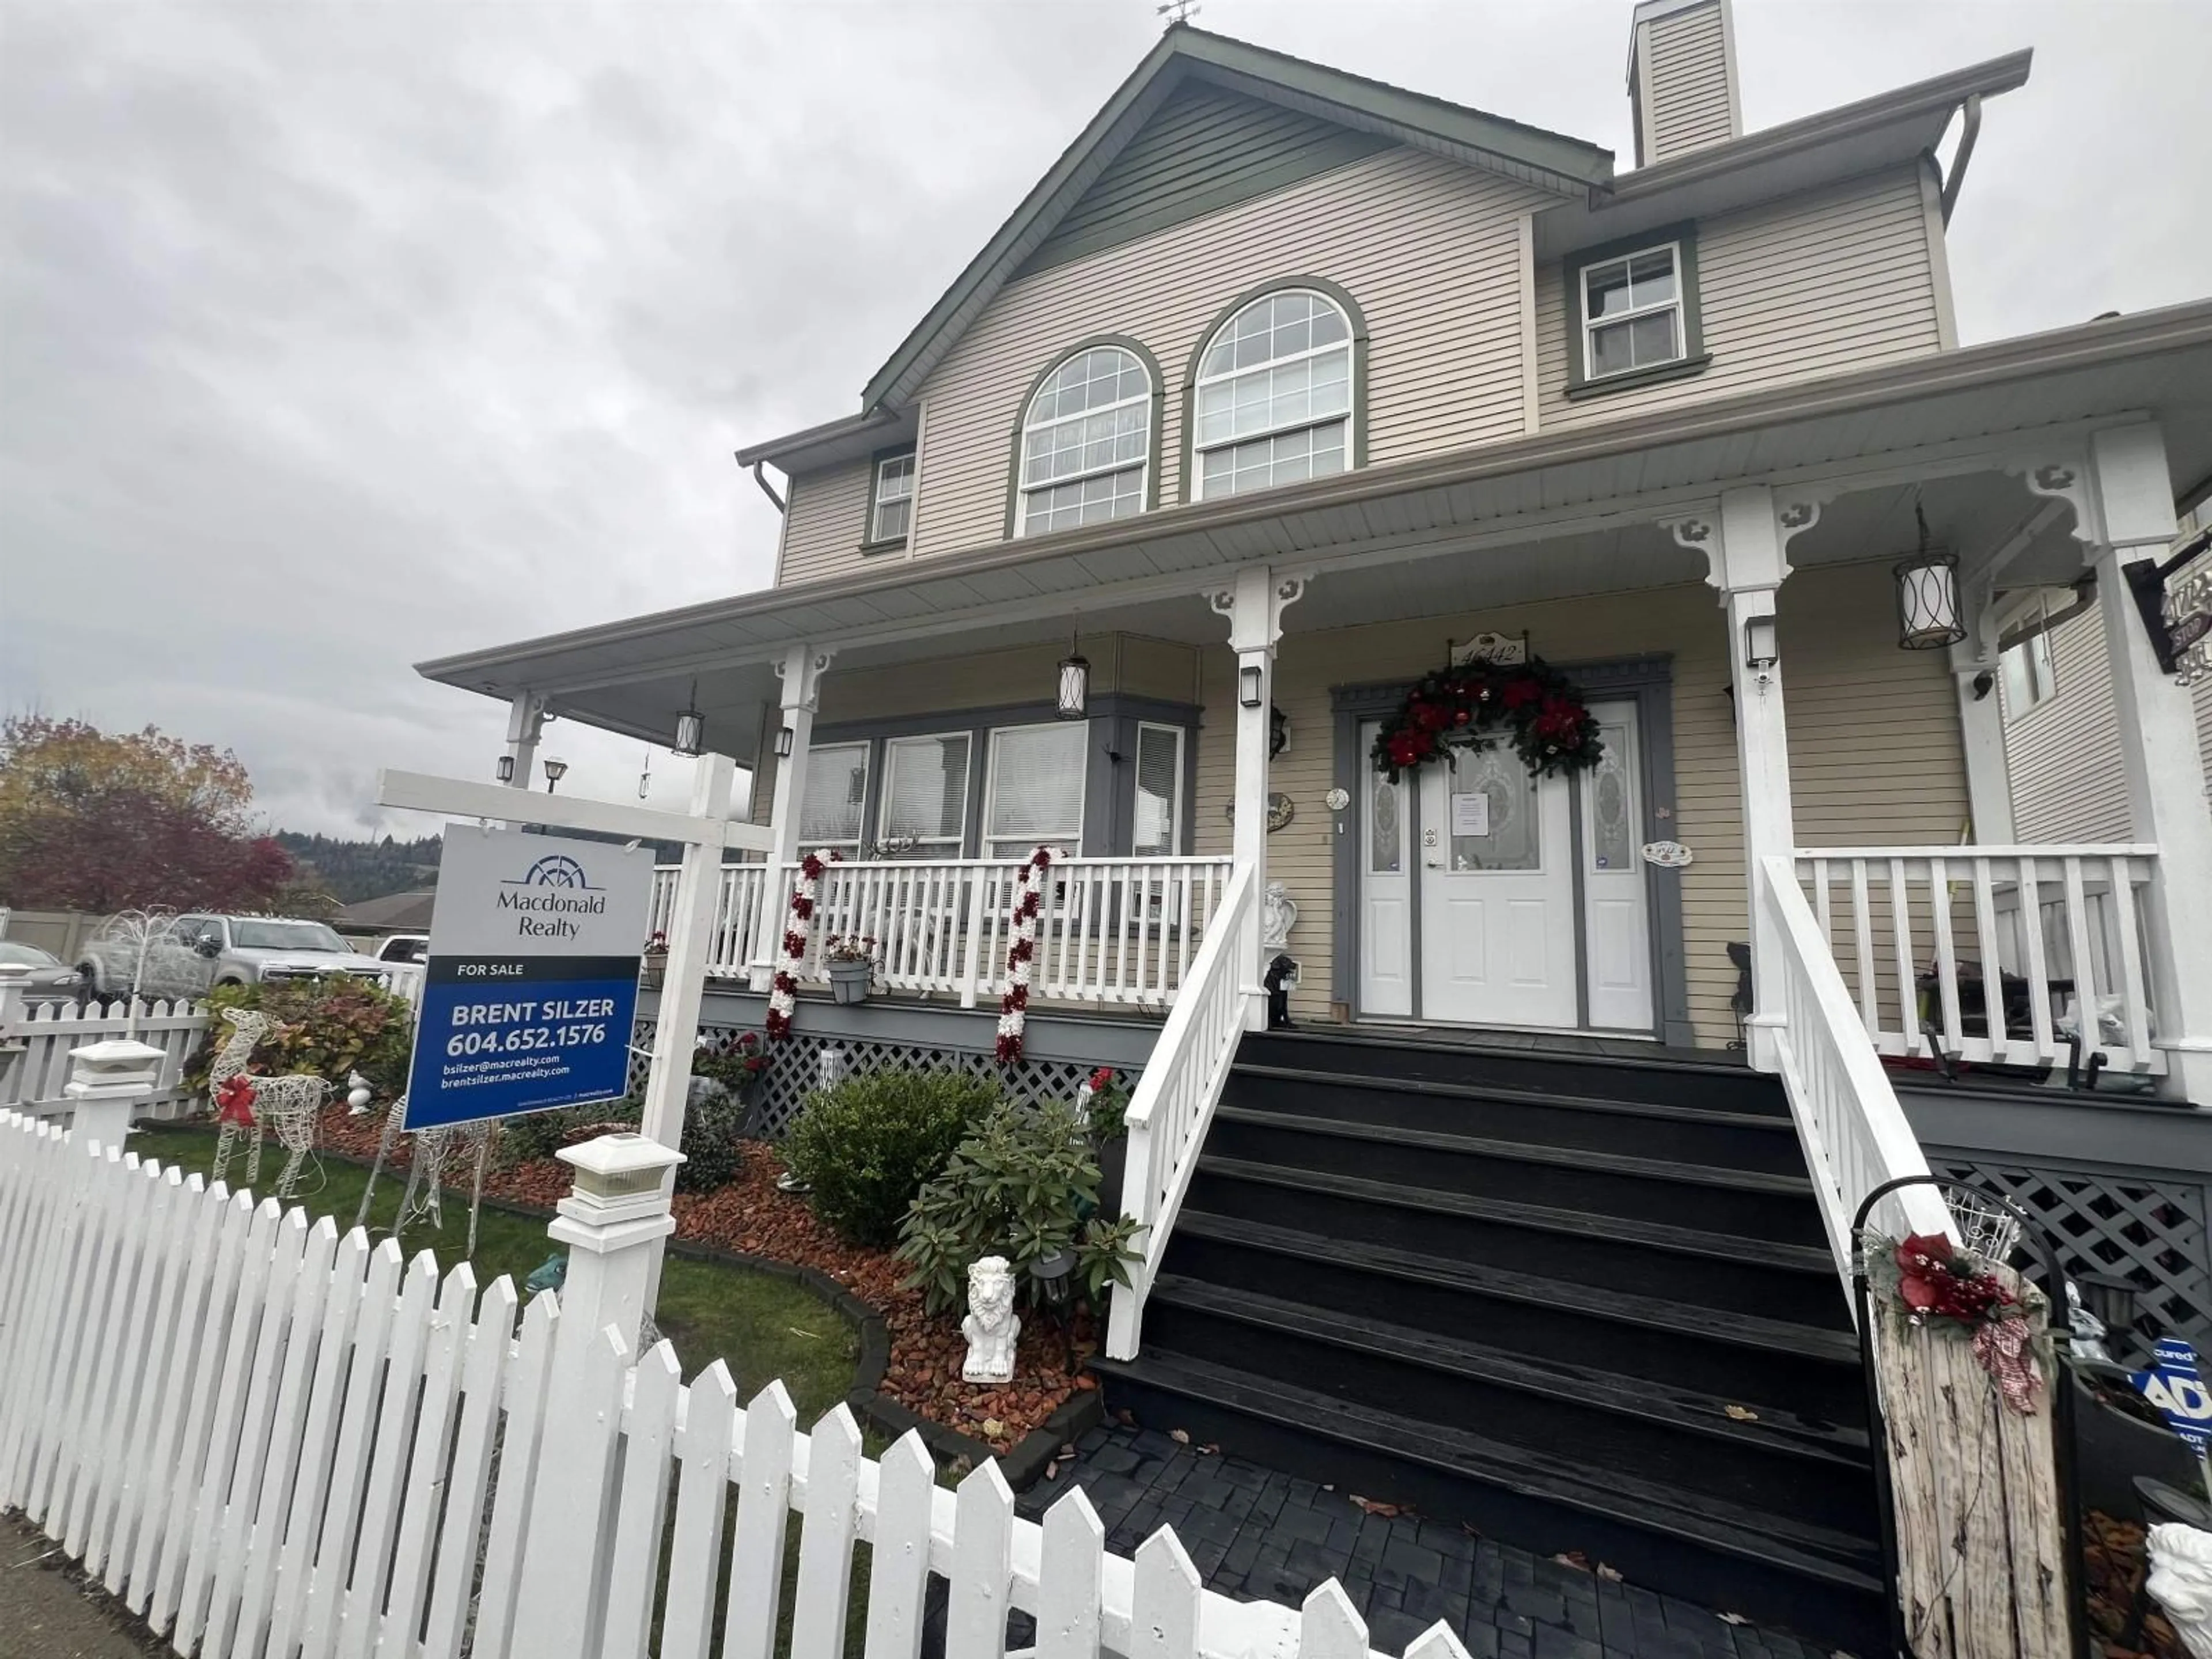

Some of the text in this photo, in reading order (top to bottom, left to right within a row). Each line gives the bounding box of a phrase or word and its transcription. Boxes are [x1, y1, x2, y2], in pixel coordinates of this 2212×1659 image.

[497, 890, 605, 914] Macdonald
[519, 916, 580, 941] Realty
[457, 964, 524, 976] FOR SALE
[452, 999, 615, 1027] BRENT SILZER
[446, 1023, 606, 1056] 604.652.1576
[443, 1055, 560, 1075] bsilzer@macrealty.com
[441, 1066, 570, 1090] brentsilzer.macrealty.com
[2143, 1373, 2212, 1419] AD
